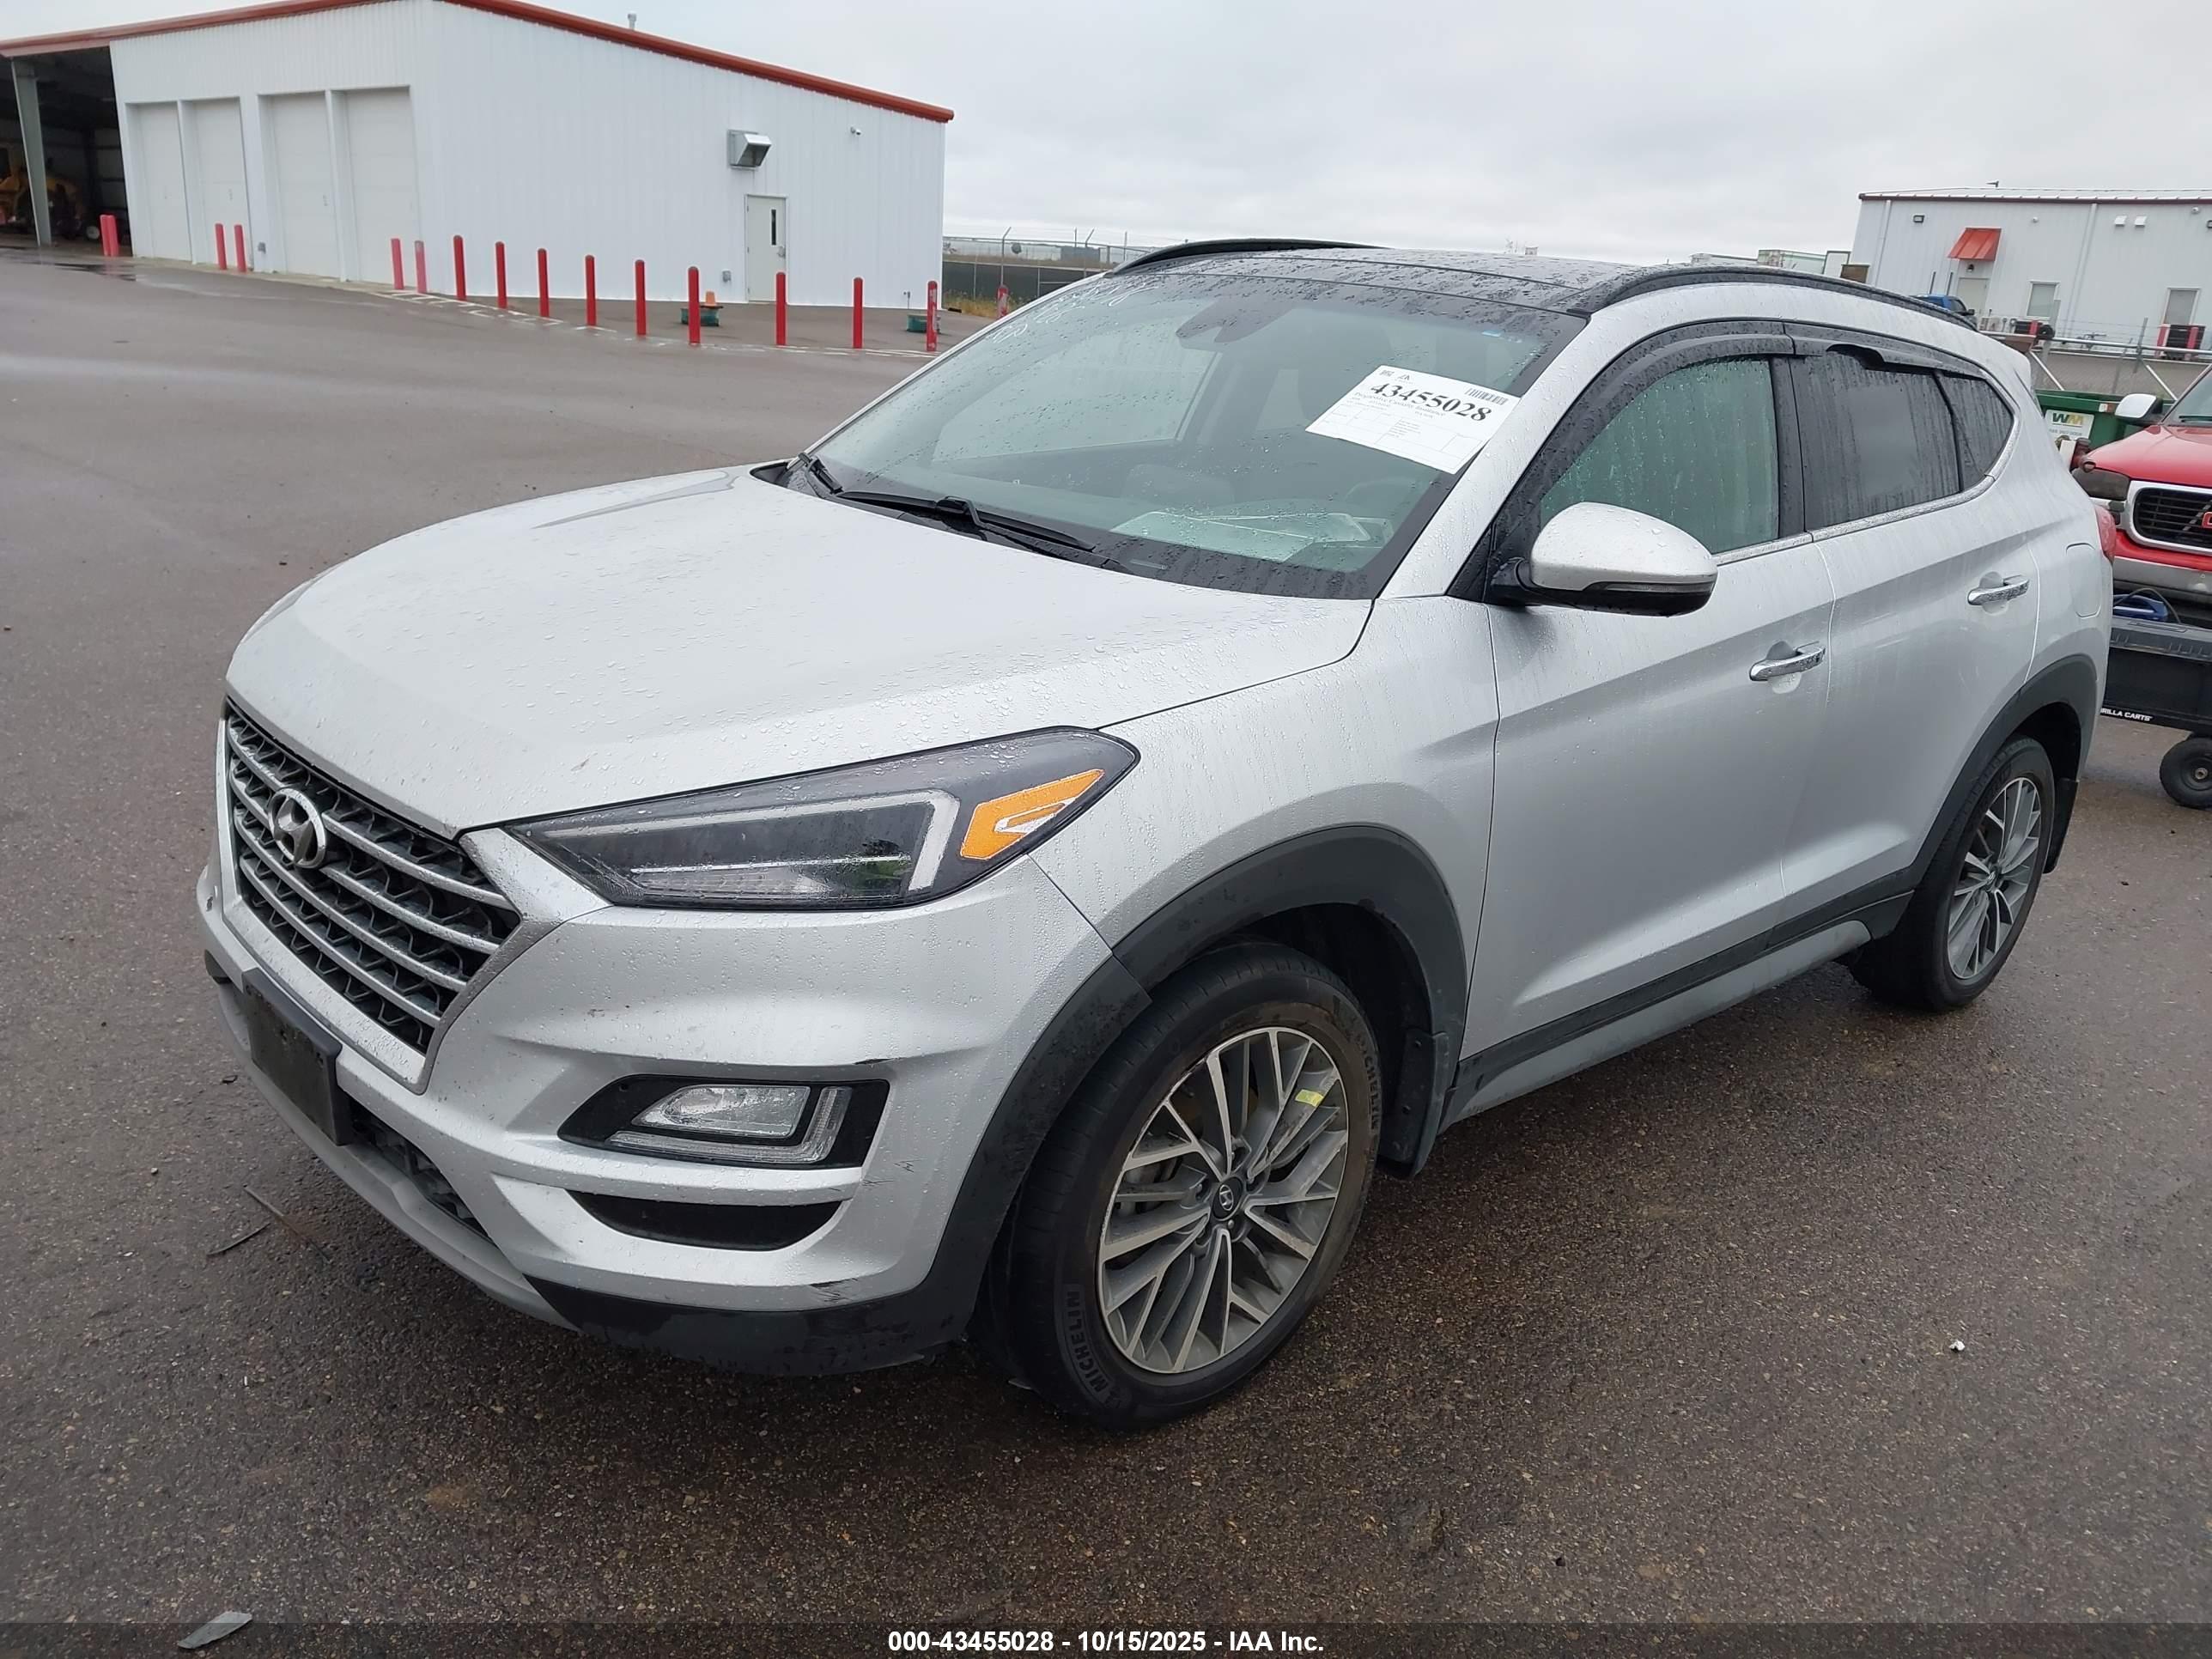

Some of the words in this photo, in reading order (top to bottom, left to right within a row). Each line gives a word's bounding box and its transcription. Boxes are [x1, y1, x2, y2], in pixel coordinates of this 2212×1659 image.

[1370, 383, 1492, 422] 43455028
[2052, 412, 2082, 426] WM
[1066, 1291, 1109, 1393] MICHELIN
